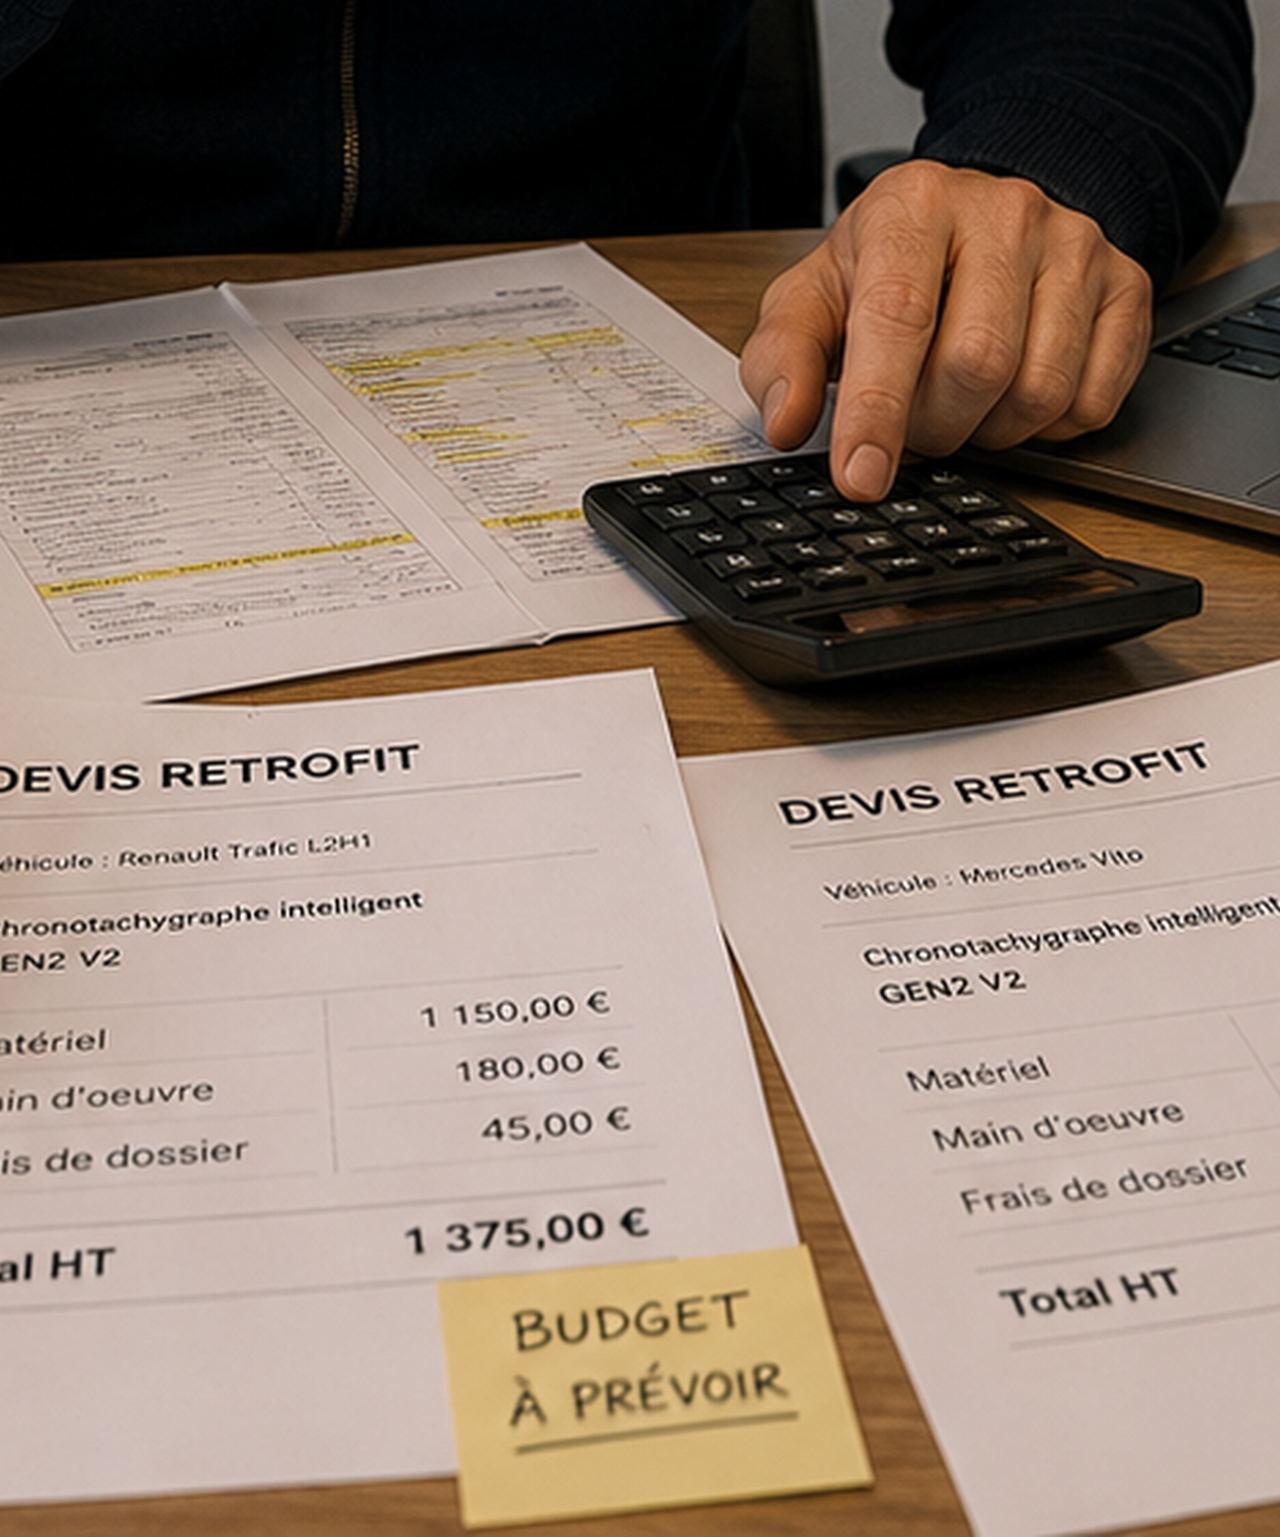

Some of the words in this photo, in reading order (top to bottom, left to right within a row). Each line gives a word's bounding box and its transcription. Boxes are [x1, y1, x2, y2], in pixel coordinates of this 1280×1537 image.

[162, 744, 419, 788] RETROFIT
[779, 785, 940, 825] DEVIS
[954, 742, 1206, 804] RETROFIT
[119, 846, 218, 866] Renault
[228, 841, 297, 859] Trafic
[824, 875, 936, 900] Véhicule
[959, 858, 1086, 884] Mercedes
[1090, 850, 1143, 866] Vito
[281, 893, 422, 918] intelligent
[80, 949, 120, 967] V2
[864, 921, 1141, 966] Chronotachygraphe
[454, 996, 574, 1025] 150,00
[879, 977, 973, 1004] GEN2
[979, 971, 1026, 991] V2
[51, 1084, 213, 1109] d'oeuvre
[457, 1051, 583, 1082] 180,00
[906, 1056, 1050, 1091] Matériel
[45, 1148, 92, 1172] de
[106, 1139, 248, 1169] dossier
[482, 1111, 592, 1142] 45,00
[932, 1122, 1023, 1151] Main
[1034, 1105, 1184, 1139] d'oeuvre
[960, 1183, 1052, 1214] Frais
[1062, 1177, 1108, 1202] de
[1119, 1159, 1246, 1194] dossier
[51, 1248, 115, 1279] HT
[447, 1212, 604, 1252] 375,00
[999, 1278, 1112, 1317] Total
[1120, 1268, 1178, 1302] HT
[513, 1290, 749, 1353] BUDGET
[509, 1376, 547, 1427] À
[571, 1362, 787, 1421] PRÉVOIR
